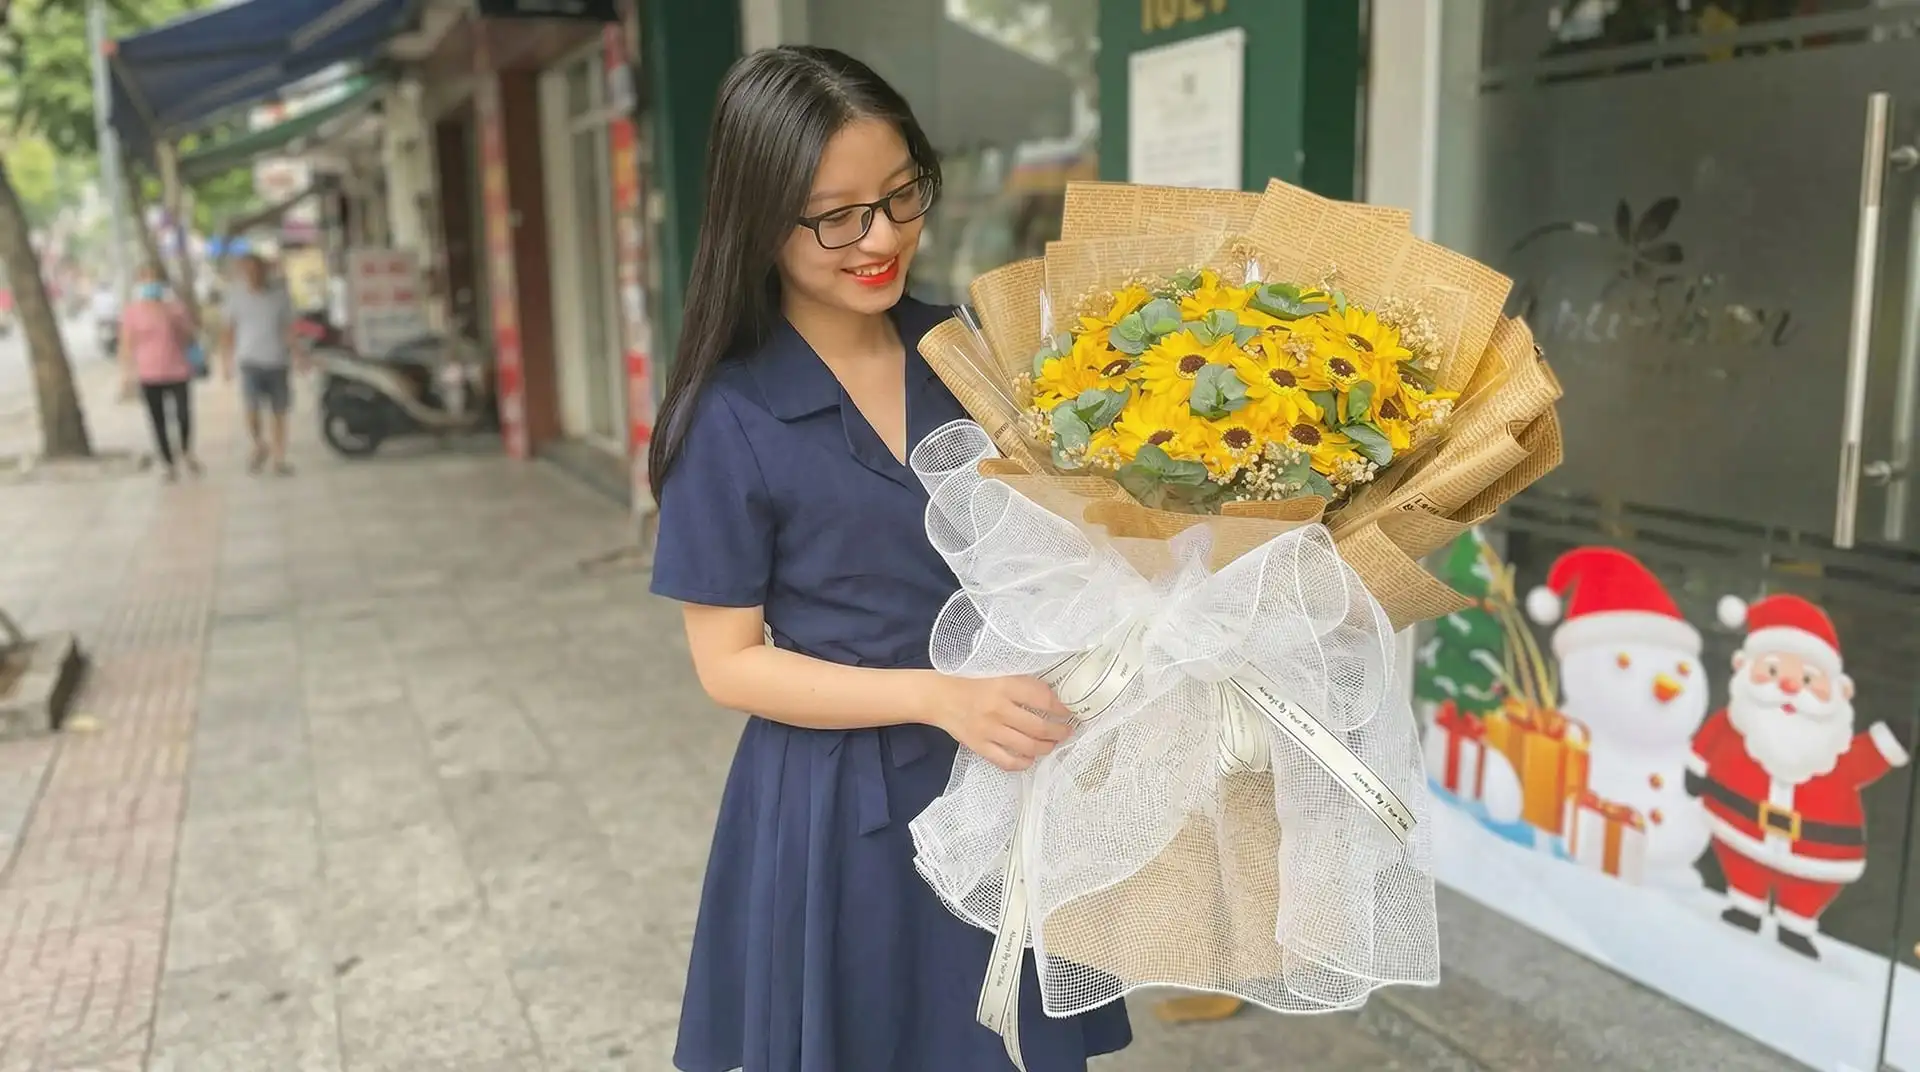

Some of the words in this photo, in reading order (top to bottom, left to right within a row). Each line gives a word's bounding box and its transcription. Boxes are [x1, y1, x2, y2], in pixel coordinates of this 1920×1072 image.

[1258, 684, 1279, 705] Always
[1279, 702, 1287, 713] By
[1287, 708, 1302, 724] Your
[1352, 772, 1375, 795] Always
[1375, 792, 1384, 805] By
